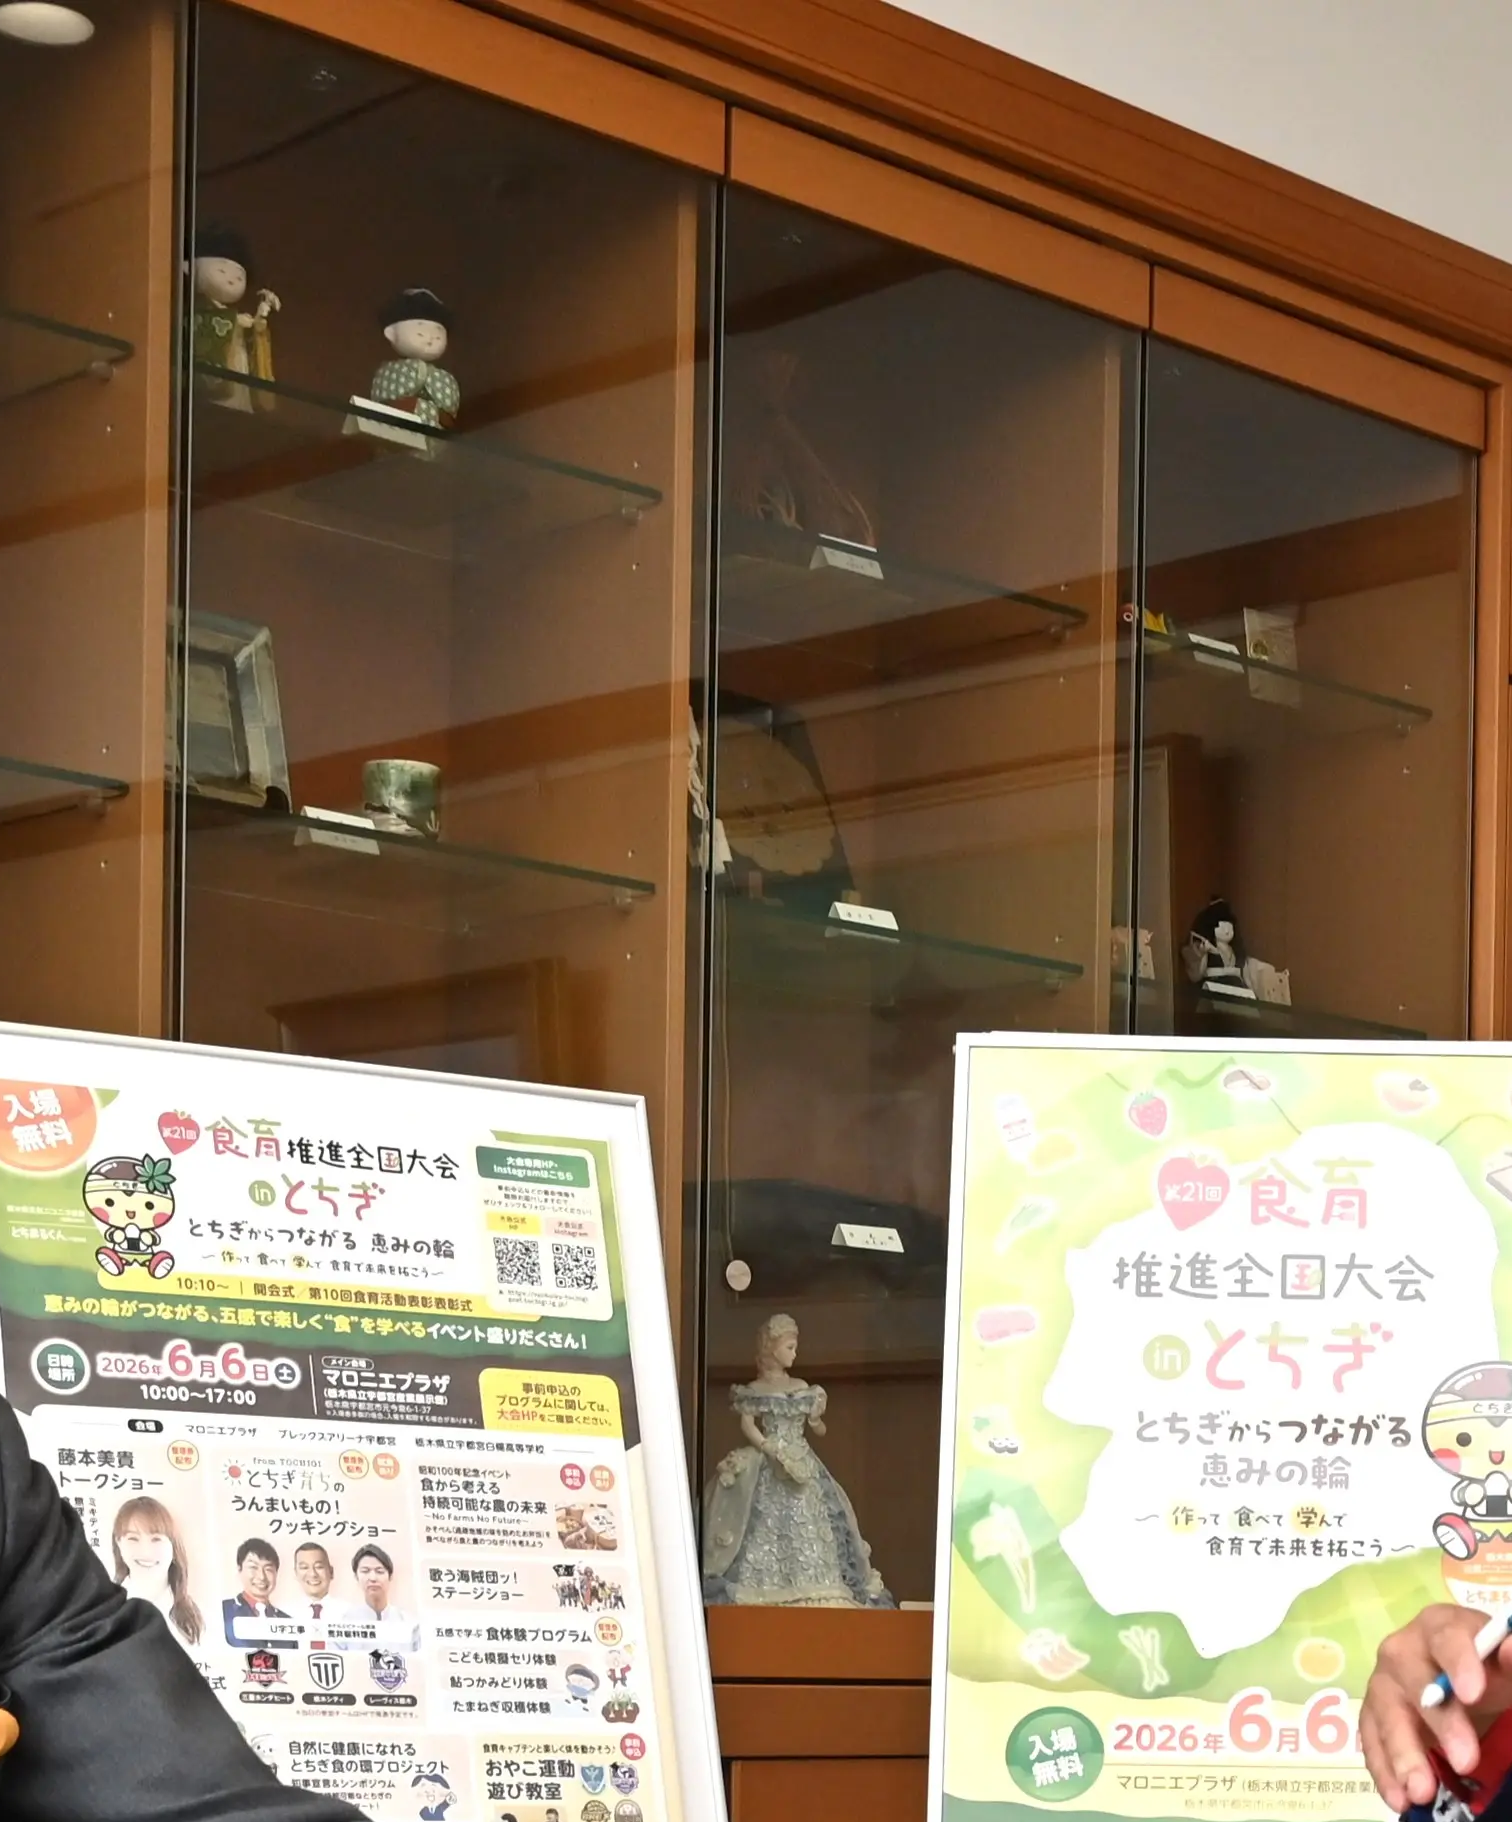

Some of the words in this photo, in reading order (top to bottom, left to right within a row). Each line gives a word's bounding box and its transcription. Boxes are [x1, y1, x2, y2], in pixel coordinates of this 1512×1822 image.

[2, 1089, 63, 1122] 入場
[12, 1119, 73, 1153] 無料
[253, 1183, 273, 1203] in
[281, 1173, 386, 1221] とちぎ
[1238, 1156, 1375, 1230] 食育
[188, 1218, 357, 1251] とちぎからつながる
[370, 1233, 456, 1260] 恵みの輪
[1112, 1250, 1435, 1303] 推進全国大会
[100, 1343, 270, 1383] 2026年6月6日
[277, 1364, 294, 1383] 土
[1153, 1341, 1183, 1373] in
[1203, 1318, 1394, 1394] とちぎ
[322, 1369, 451, 1394] マロニエプラザ
[521, 1382, 582, 1397] 事前申込の
[185, 1424, 258, 1438] マロニエプラザ
[1136, 1410, 1412, 1448] とちぎからつながる
[57, 1448, 135, 1470] 藤本美貴
[58, 1471, 165, 1491] トークショー
[418, 1465, 512, 1480] 昭和100年記念イベント
[1199, 1452, 1352, 1490] 恵みの輪
[420, 1478, 501, 1495] 食から考える
[422, 1495, 549, 1515] 持続可能な農の未来
[269, 1517, 398, 1539] クッキングショー
[1233, 1505, 1284, 1528] 食べて
[1296, 1506, 1348, 1529] 学んで
[432, 1586, 525, 1601] ステージショー
[435, 1627, 483, 1639] 五感で学ぶ
[486, 1626, 593, 1643] 食体験プログラム
[448, 1651, 557, 1666] こども模擬セリ体験
[450, 1675, 549, 1690] 鮎つかみどり体験
[452, 1700, 552, 1714] たまねぎ収穫体験
[288, 1740, 417, 1757] 自然に健康になれる
[1027, 1725, 1078, 1761] 入場
[290, 1759, 450, 1774] とちぎ食の環プロジェクト
[485, 1758, 576, 1779] おやこ運動
[1031, 1754, 1084, 1788] 無料
[487, 1781, 563, 1801] 遊び教室
[1116, 1773, 1238, 1792] マロニエプラザ
[1241, 1779, 1379, 1795] (栃木県立宇都宮産業
